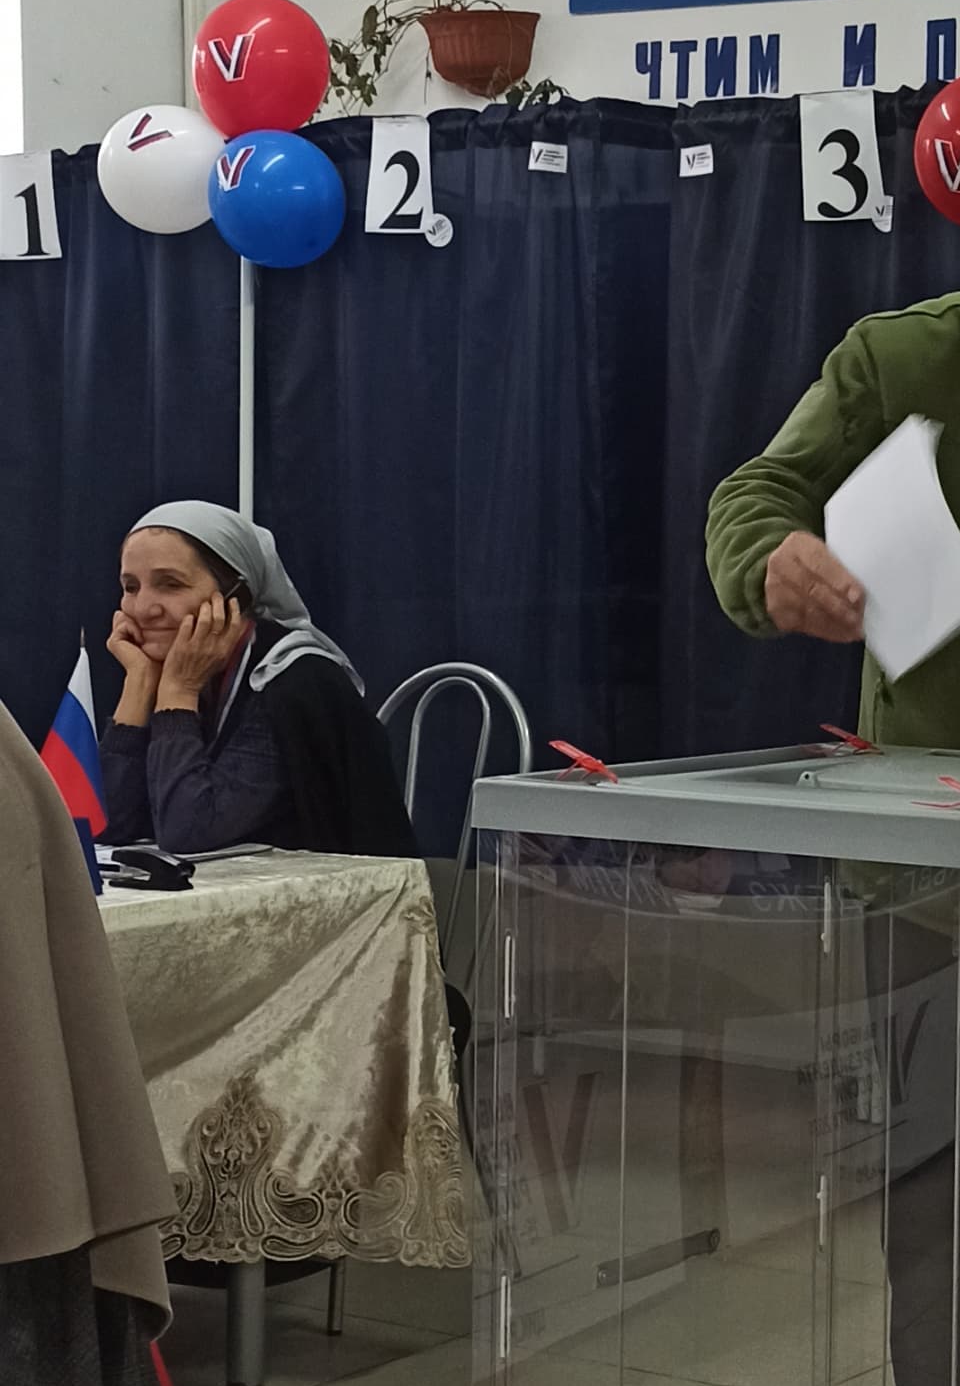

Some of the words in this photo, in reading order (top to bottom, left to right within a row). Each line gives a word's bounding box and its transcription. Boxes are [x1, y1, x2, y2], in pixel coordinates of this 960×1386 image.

[636, 33, 780, 101] ЧТИМ
[843, 23, 877, 87] И
[379, 150, 424, 230] 2
[818, 129, 868, 218] 3
[15, 183, 50, 257] 1
